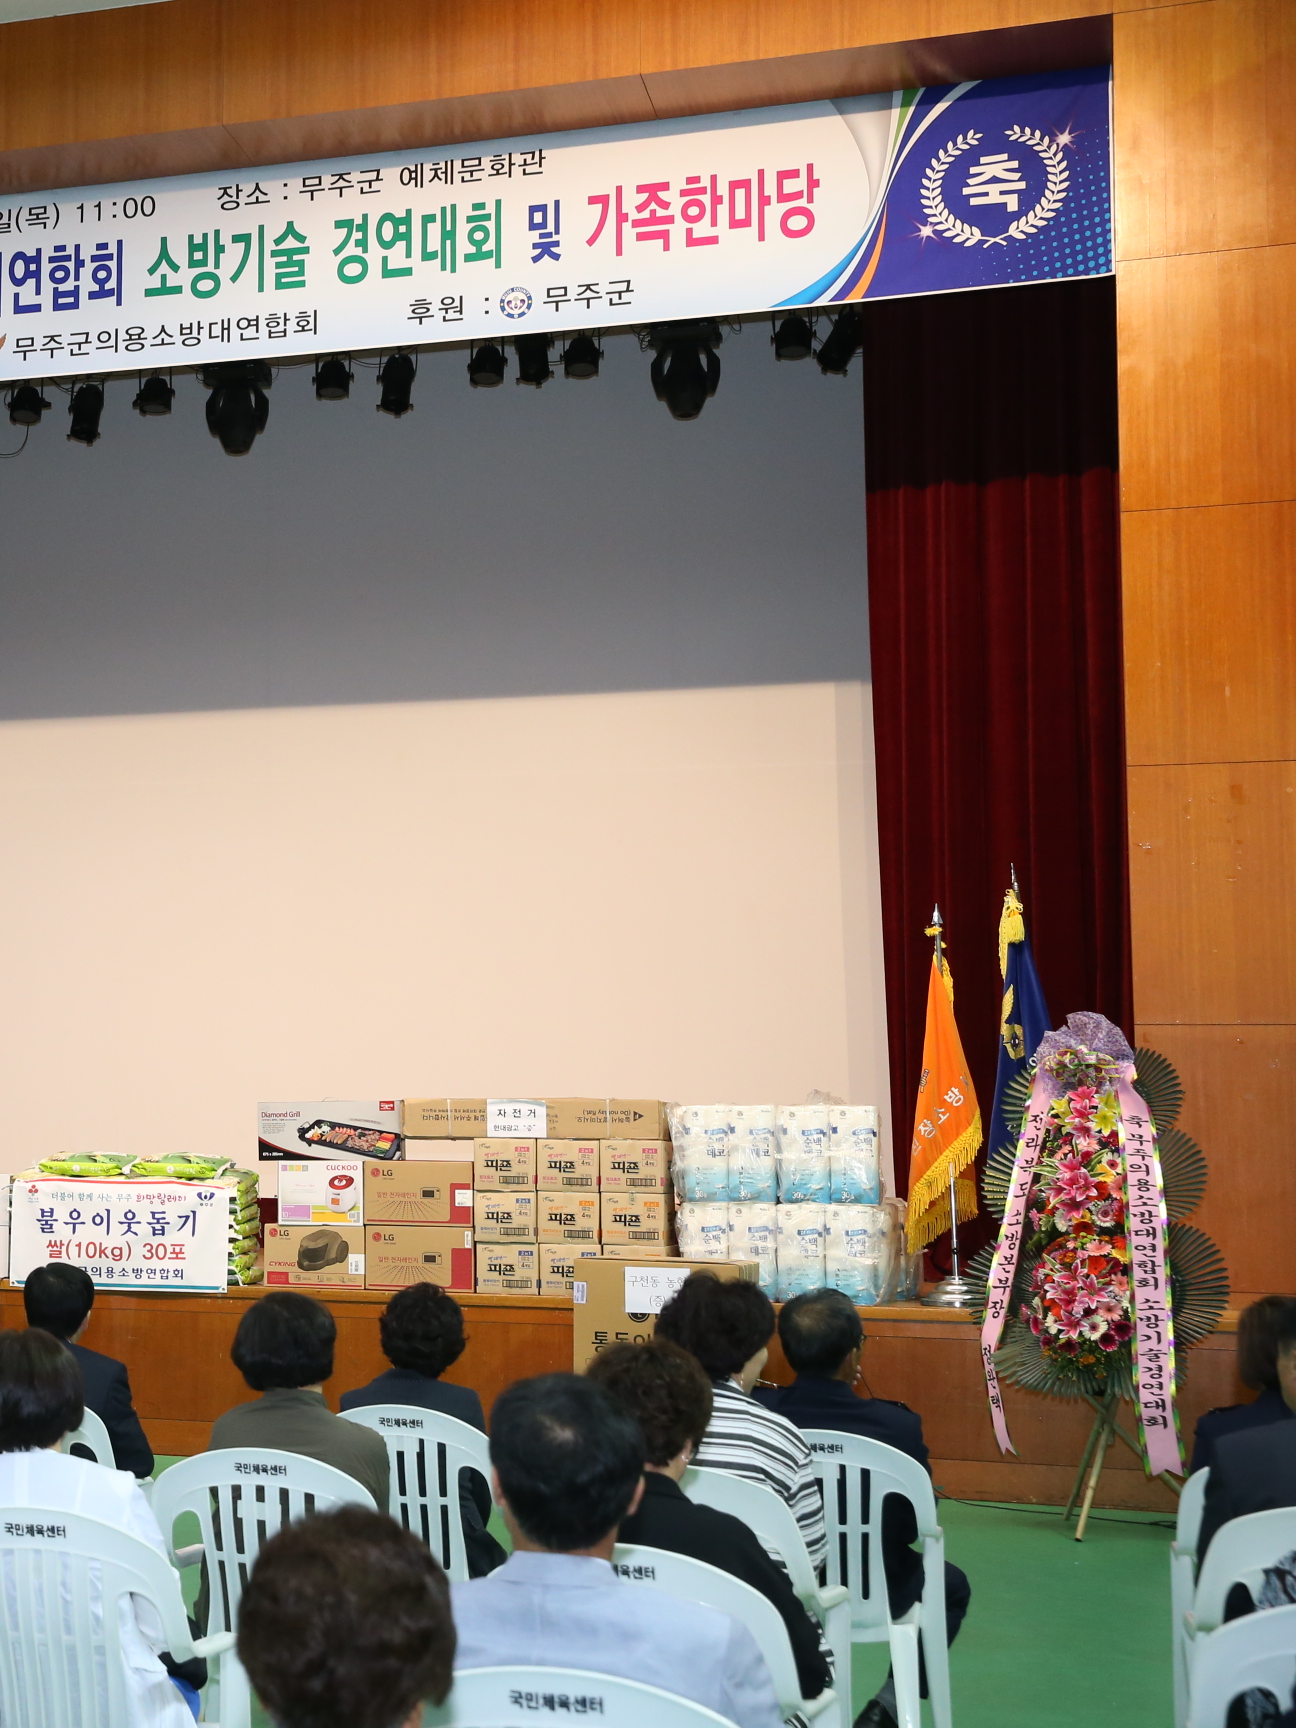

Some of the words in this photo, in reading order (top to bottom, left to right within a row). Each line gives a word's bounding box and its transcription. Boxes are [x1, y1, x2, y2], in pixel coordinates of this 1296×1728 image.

[217, 182, 271, 212] 장소
[299, 168, 384, 202] 무주군
[399, 149, 547, 189] 예체문화관
[962, 153, 1027, 212] 축
[76, 195, 156, 224] 11:00
[144, 220, 311, 299] 소방기술
[332, 198, 503, 285] 경연대회
[528, 199, 562, 265] 및
[586, 162, 821, 257] 가족한마당
[407, 295, 465, 325] 후원
[543, 279, 635, 313] 무주군
[12, 309, 319, 362] 무주군의용소방대연합회
[382, 1169, 393, 1177] LG
[484, 1159, 512, 1172] 피죤
[547, 1160, 576, 1173] 피죤
[611, 1161, 640, 1174] 피죤
[36, 1207, 198, 1238] 불우이웃돕기
[485, 1211, 513, 1224] 피죤
[548, 1212, 576, 1226] 피죤
[612, 1214, 641, 1227] 피죤
[279, 1229, 290, 1237] LG
[46, 1239, 132, 1263] 쌀(10kg)
[142, 1243, 187, 1261] 30포
[487, 1263, 515, 1276] 피죤
[550, 1265, 574, 1277] 피죤
[988, 1210, 1022, 1320] 소방본부장
[628, 1275, 661, 1288] 구천동
[1136, 1298, 1169, 1430] 소방기술경연대회
[378, 1416, 423, 1429] 국민체육센터
[234, 1462, 287, 1477] 국민체육센터
[4, 1522, 66, 1538] 국민체육센터
[509, 1689, 604, 1715] 국민체육센터
